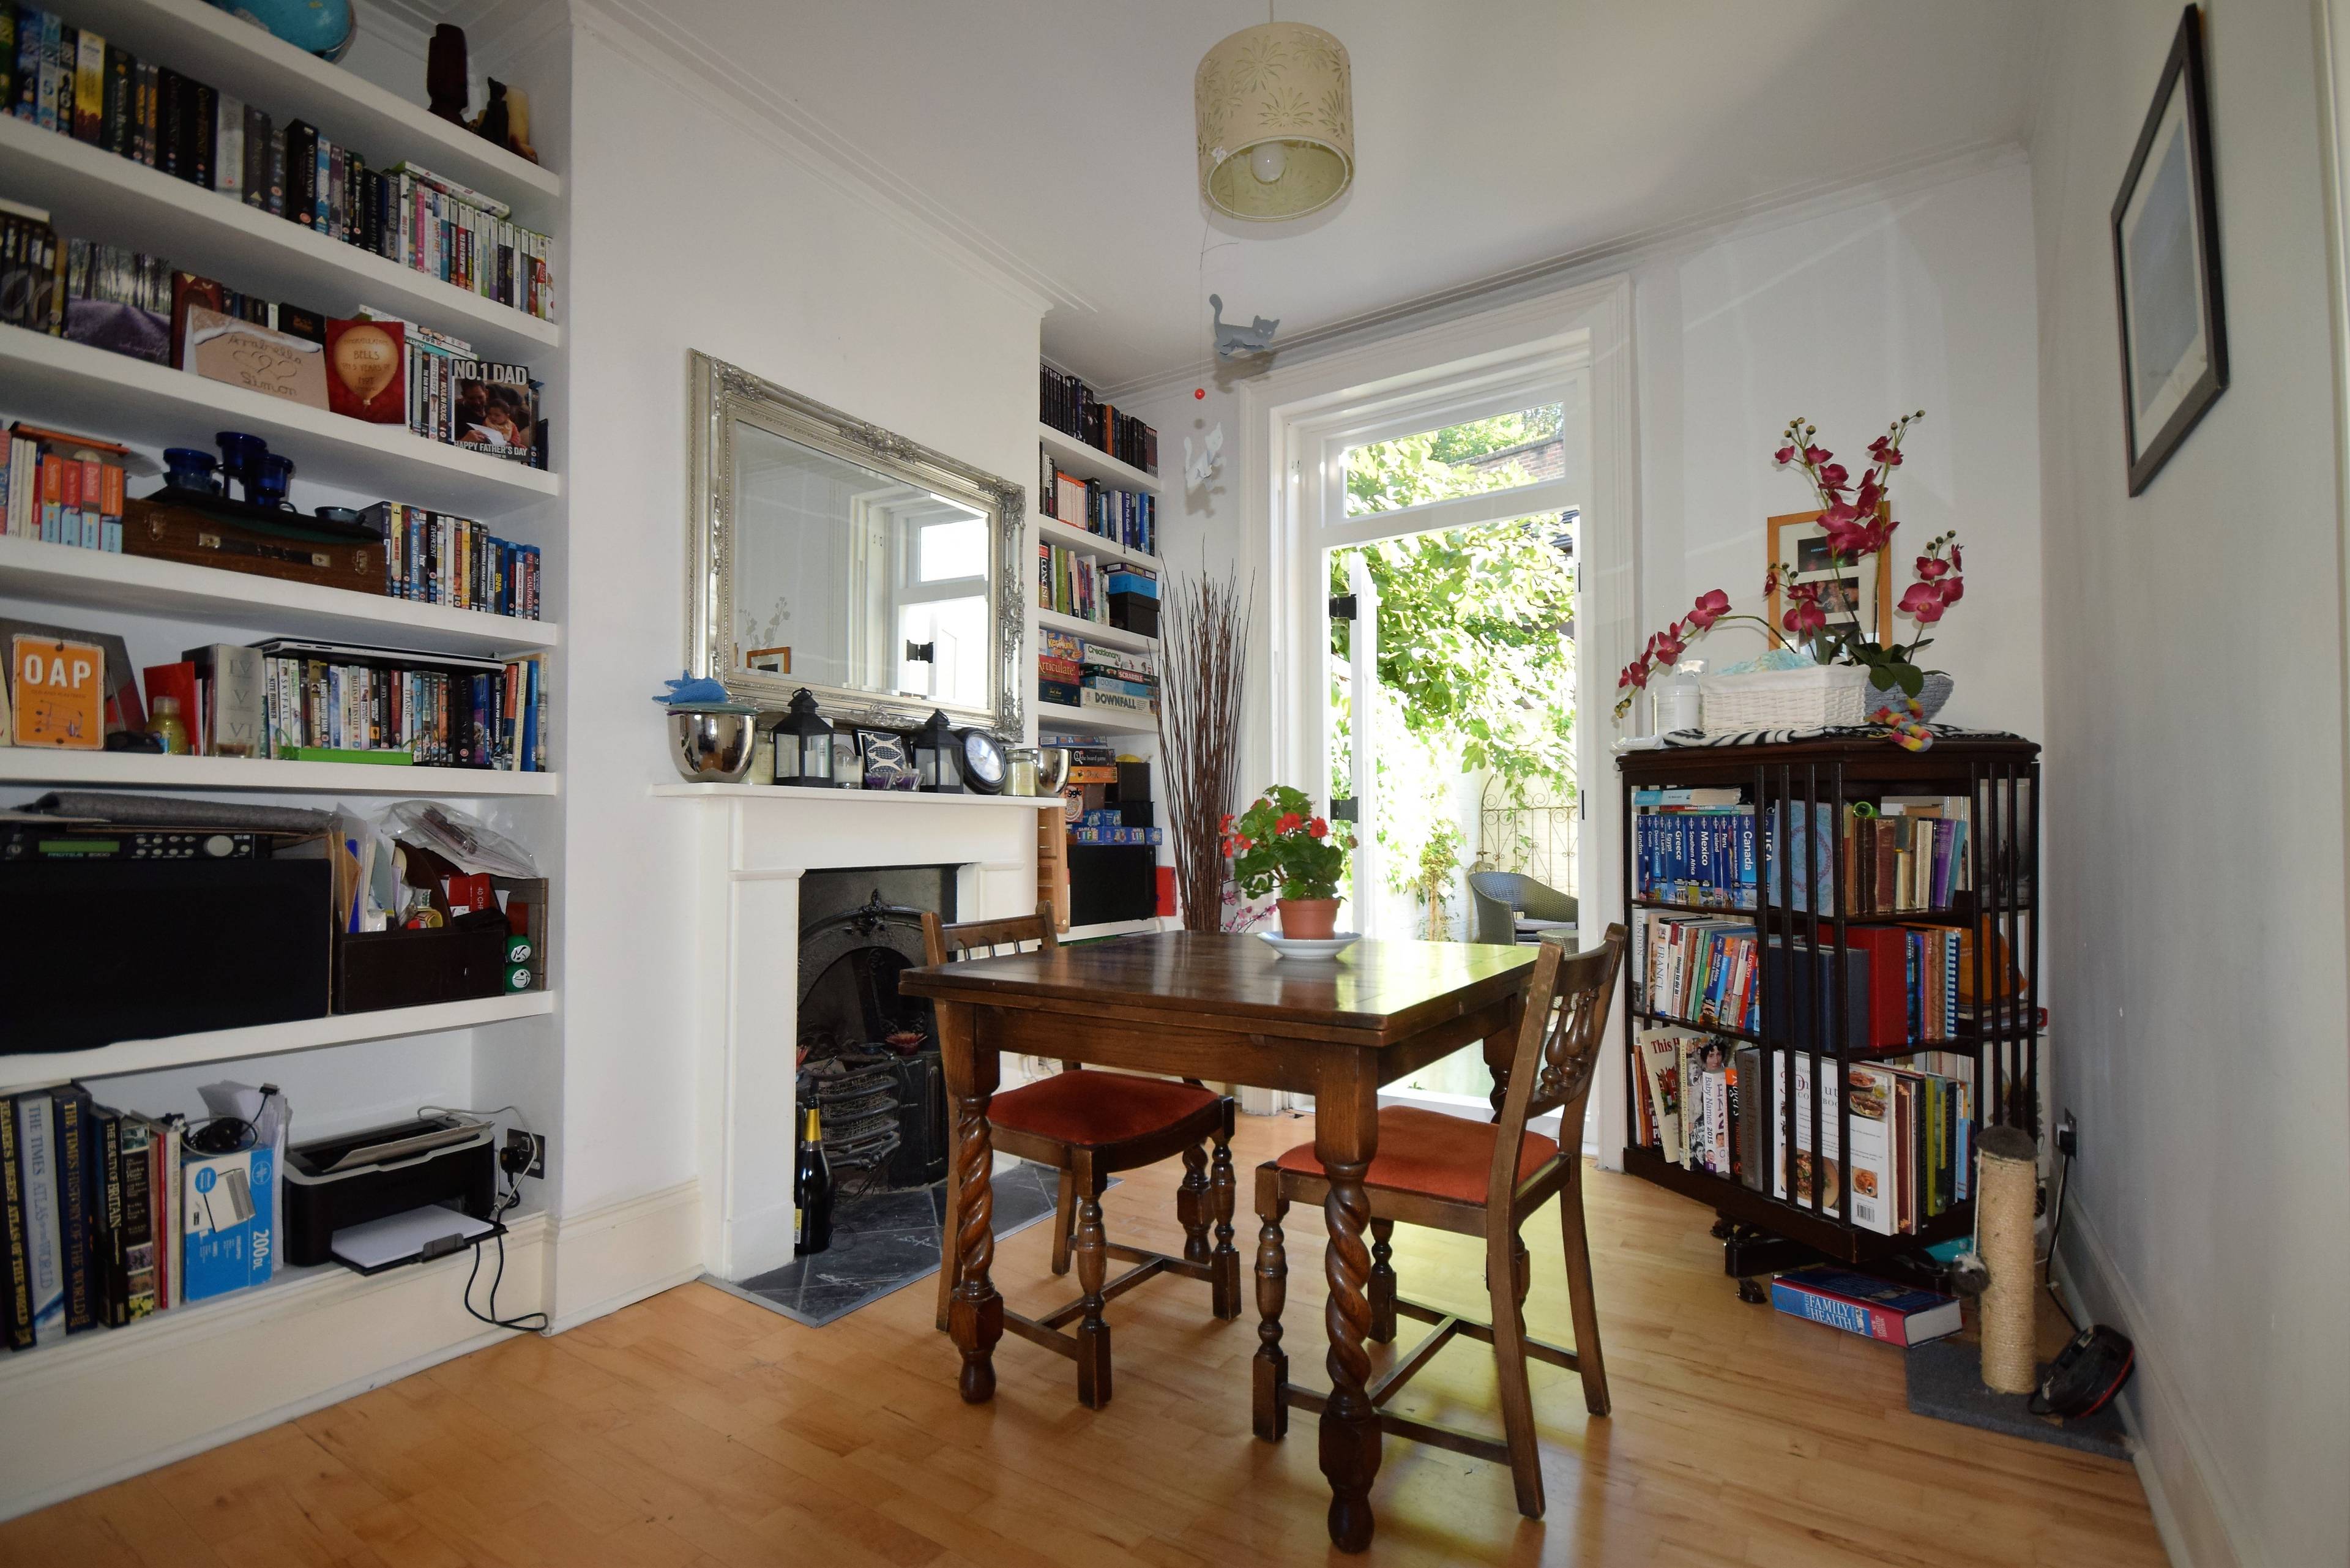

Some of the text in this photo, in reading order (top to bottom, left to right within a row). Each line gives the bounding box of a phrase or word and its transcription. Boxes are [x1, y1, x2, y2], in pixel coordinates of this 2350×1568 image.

[369, 184, 378, 215] planet
[241, 371, 298, 396] Simon
[453, 360, 528, 385] NO.1 DAD
[453, 441, 478, 452] HAPPY
[479, 442, 513, 455] FATHER'S
[513, 446, 528, 457] DAY
[86, 467, 98, 496] Dublin
[229, 659, 253, 674] IV
[1087, 646, 1121, 662] Creationary
[23, 653, 92, 689] OAP
[1038, 658, 1076, 676] Articulate!
[1118, 671, 1143, 682] SCRABBLE
[233, 689, 250, 704] V
[1095, 692, 1136, 709] DOWNFALL
[230, 722, 253, 739] VI
[1077, 831, 1099, 840] LIFE
[1700, 831, 1709, 866] Mexico
[1742, 831, 1753, 871] Canada
[477, 887, 483, 895] 40
[1656, 946, 1665, 990] FRANCE
[1728, 955, 1736, 980] Barcelona
[1745, 954, 1755, 979] London
[1650, 1038, 1673, 1054] This
[1704, 1077, 1713, 1096] Baby
[1744, 1059, 1756, 1171] Universal Dictionary
[106, 1122, 122, 1228] THE BEAUTY OF BRITAIN
[29, 1105, 54, 1289] THE TIMES ATLAS WORLD
[64, 1101, 86, 1315] THE TIMES HISTORY OF THE WORLD
[9, 1204, 21, 1242] ATLAS
[14, 1284, 29, 1325] WORLD
[1810, 1295, 1849, 1316] FAMILY
[1811, 1308, 1853, 1330] HEALTH
